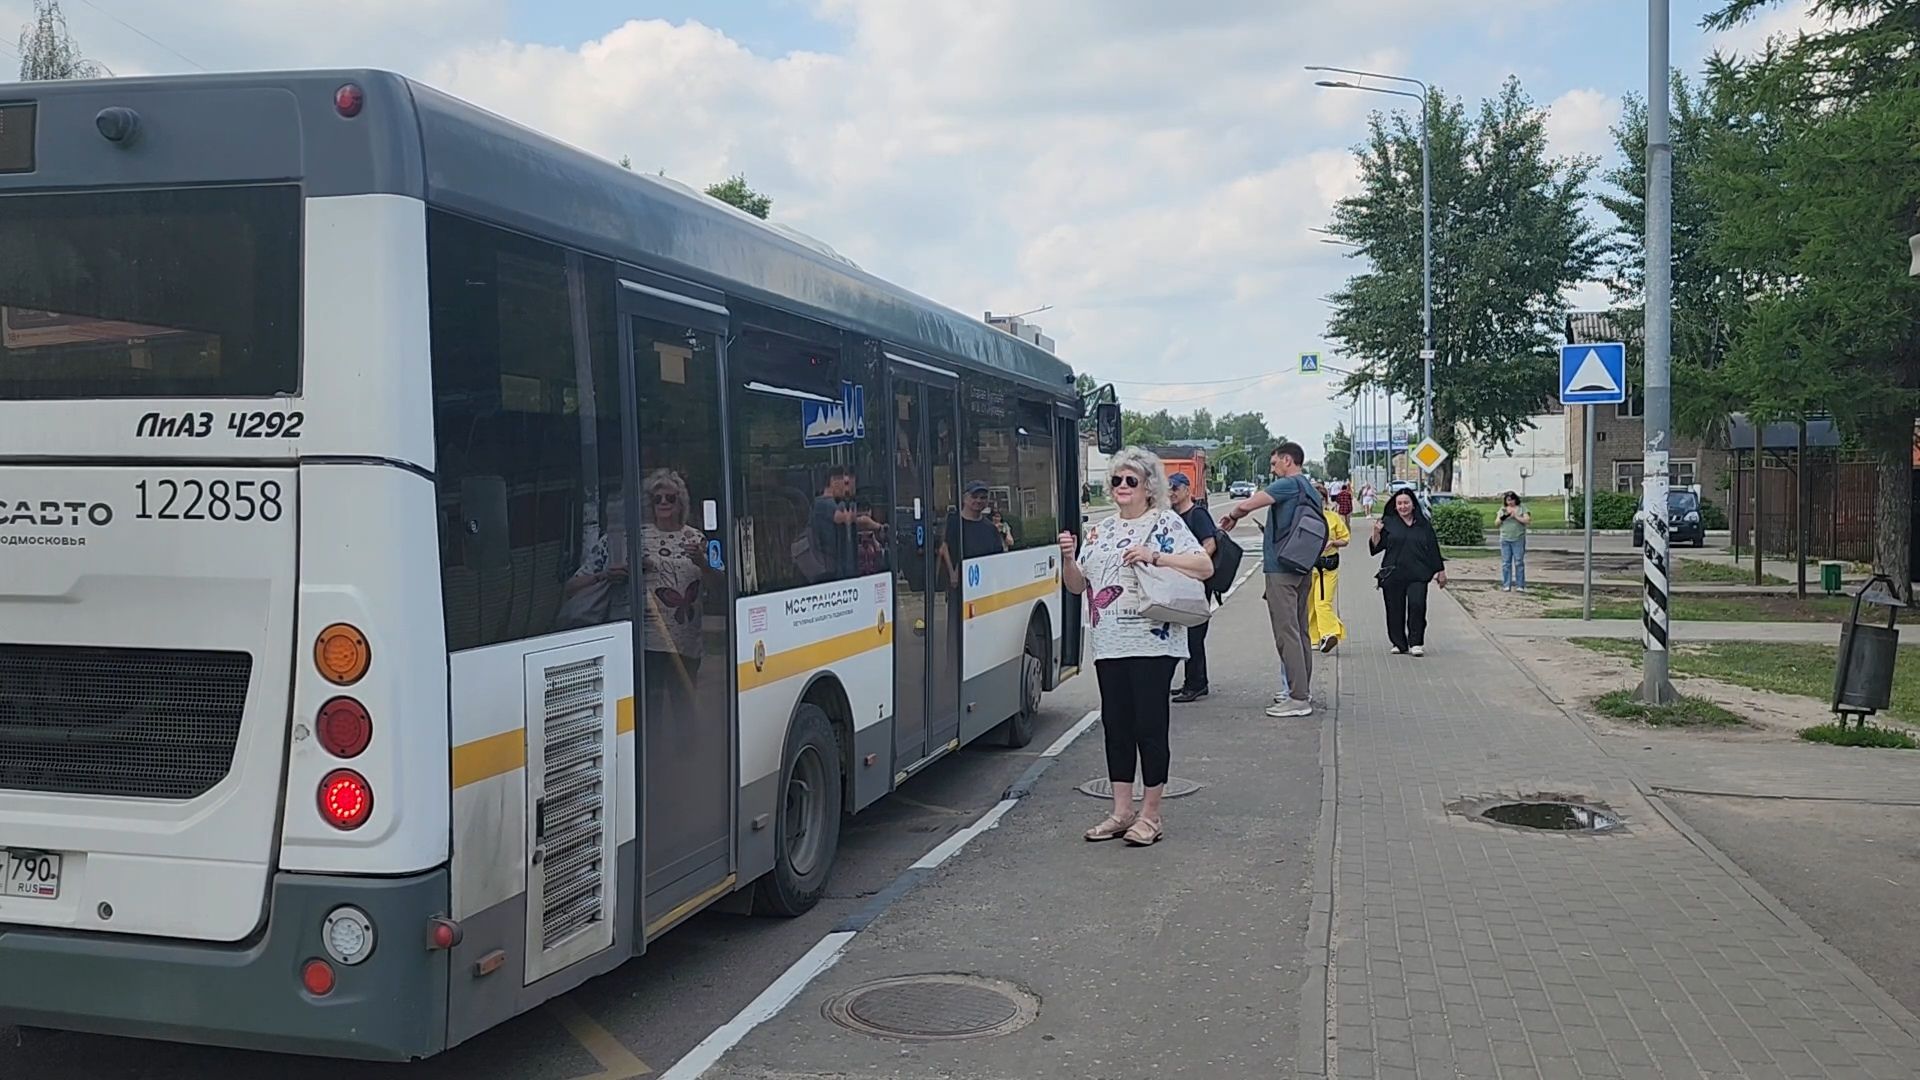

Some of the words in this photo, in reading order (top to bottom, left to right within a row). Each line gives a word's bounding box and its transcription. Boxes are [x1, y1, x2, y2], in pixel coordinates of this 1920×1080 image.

[227, 411, 304, 438] 4292
[135, 479, 282, 521] 122858
[785, 588, 859, 615] МОСТРАНСАВТО
[11, 855, 51, 882] 790
[17, 882, 39, 894] RUS
